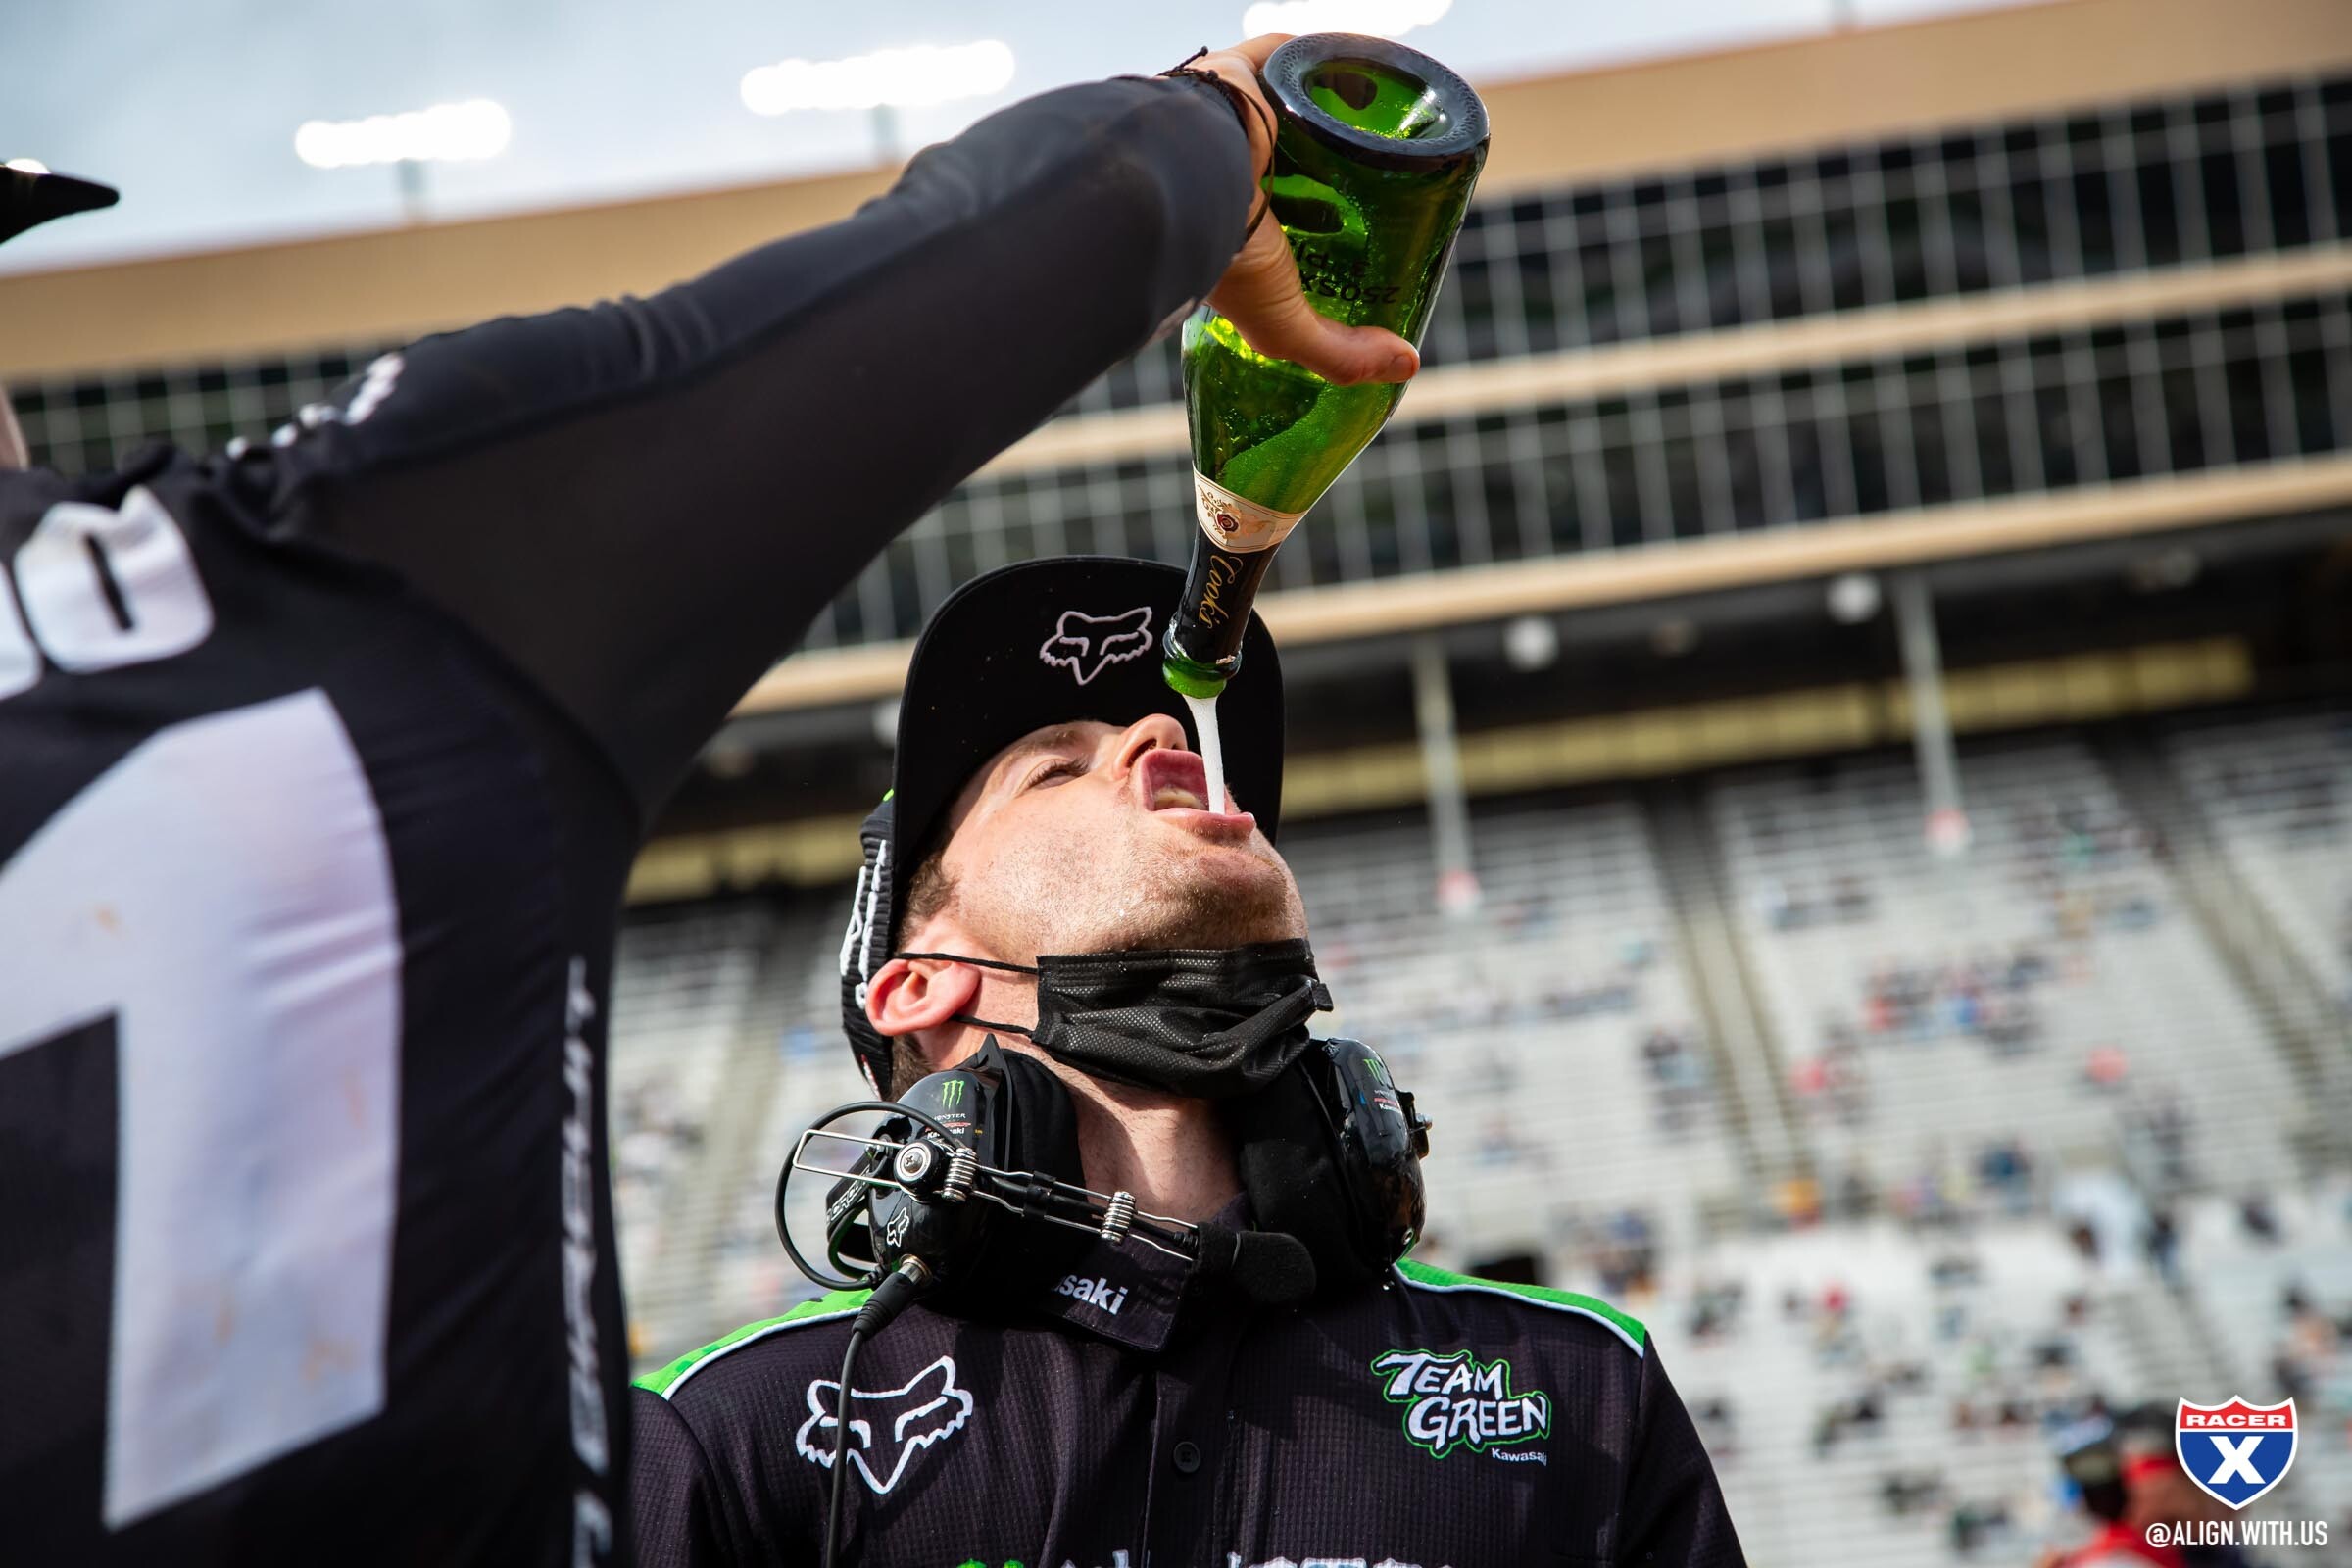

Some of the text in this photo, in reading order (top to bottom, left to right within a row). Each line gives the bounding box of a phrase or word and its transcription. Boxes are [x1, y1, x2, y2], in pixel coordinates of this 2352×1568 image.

[1198, 553, 1244, 629] Cook's
[1053, 1273, 1129, 1316] saki
[1375, 1352, 1503, 1401] TEAM
[1407, 1394, 1547, 1450] GREEN
